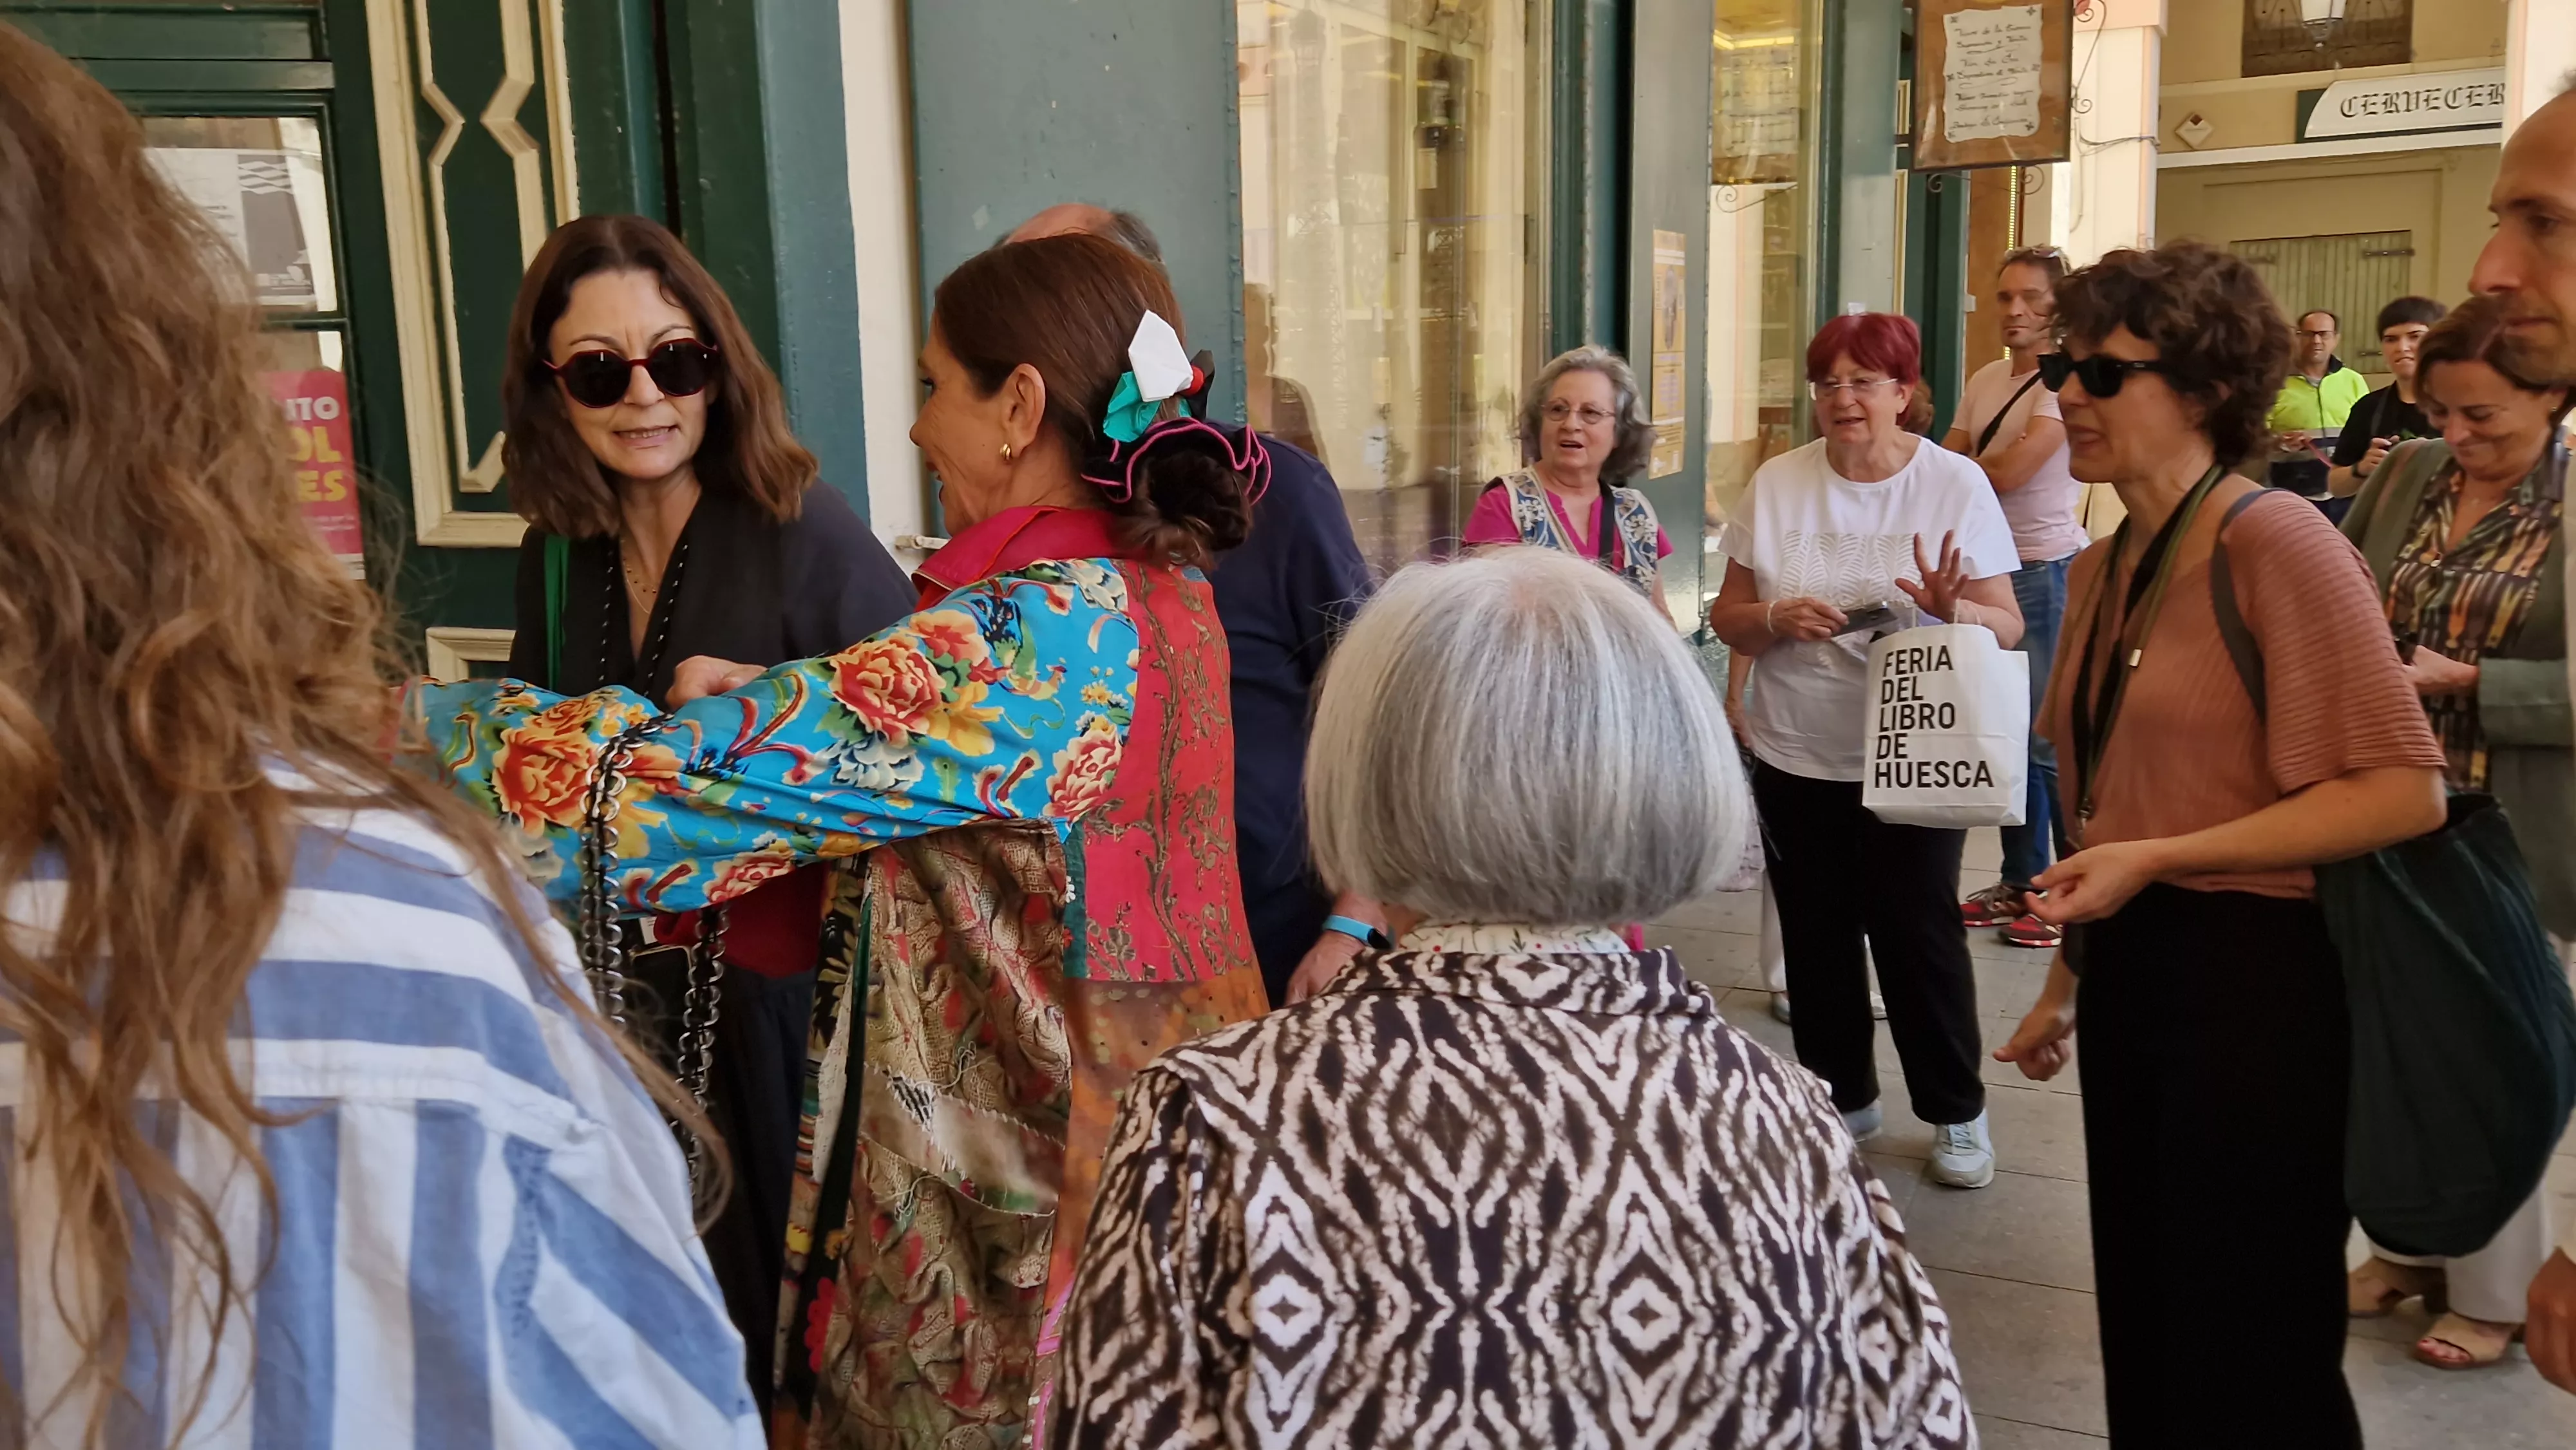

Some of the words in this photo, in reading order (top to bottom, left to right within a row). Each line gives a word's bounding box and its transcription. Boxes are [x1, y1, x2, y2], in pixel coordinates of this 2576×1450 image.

[1882, 645, 1954, 677] FERIA
[1880, 676, 1924, 705] DEL
[1879, 702, 1956, 733] LIBRO
[1875, 733, 1908, 760] DE
[1874, 760, 1994, 789] HUESCA
